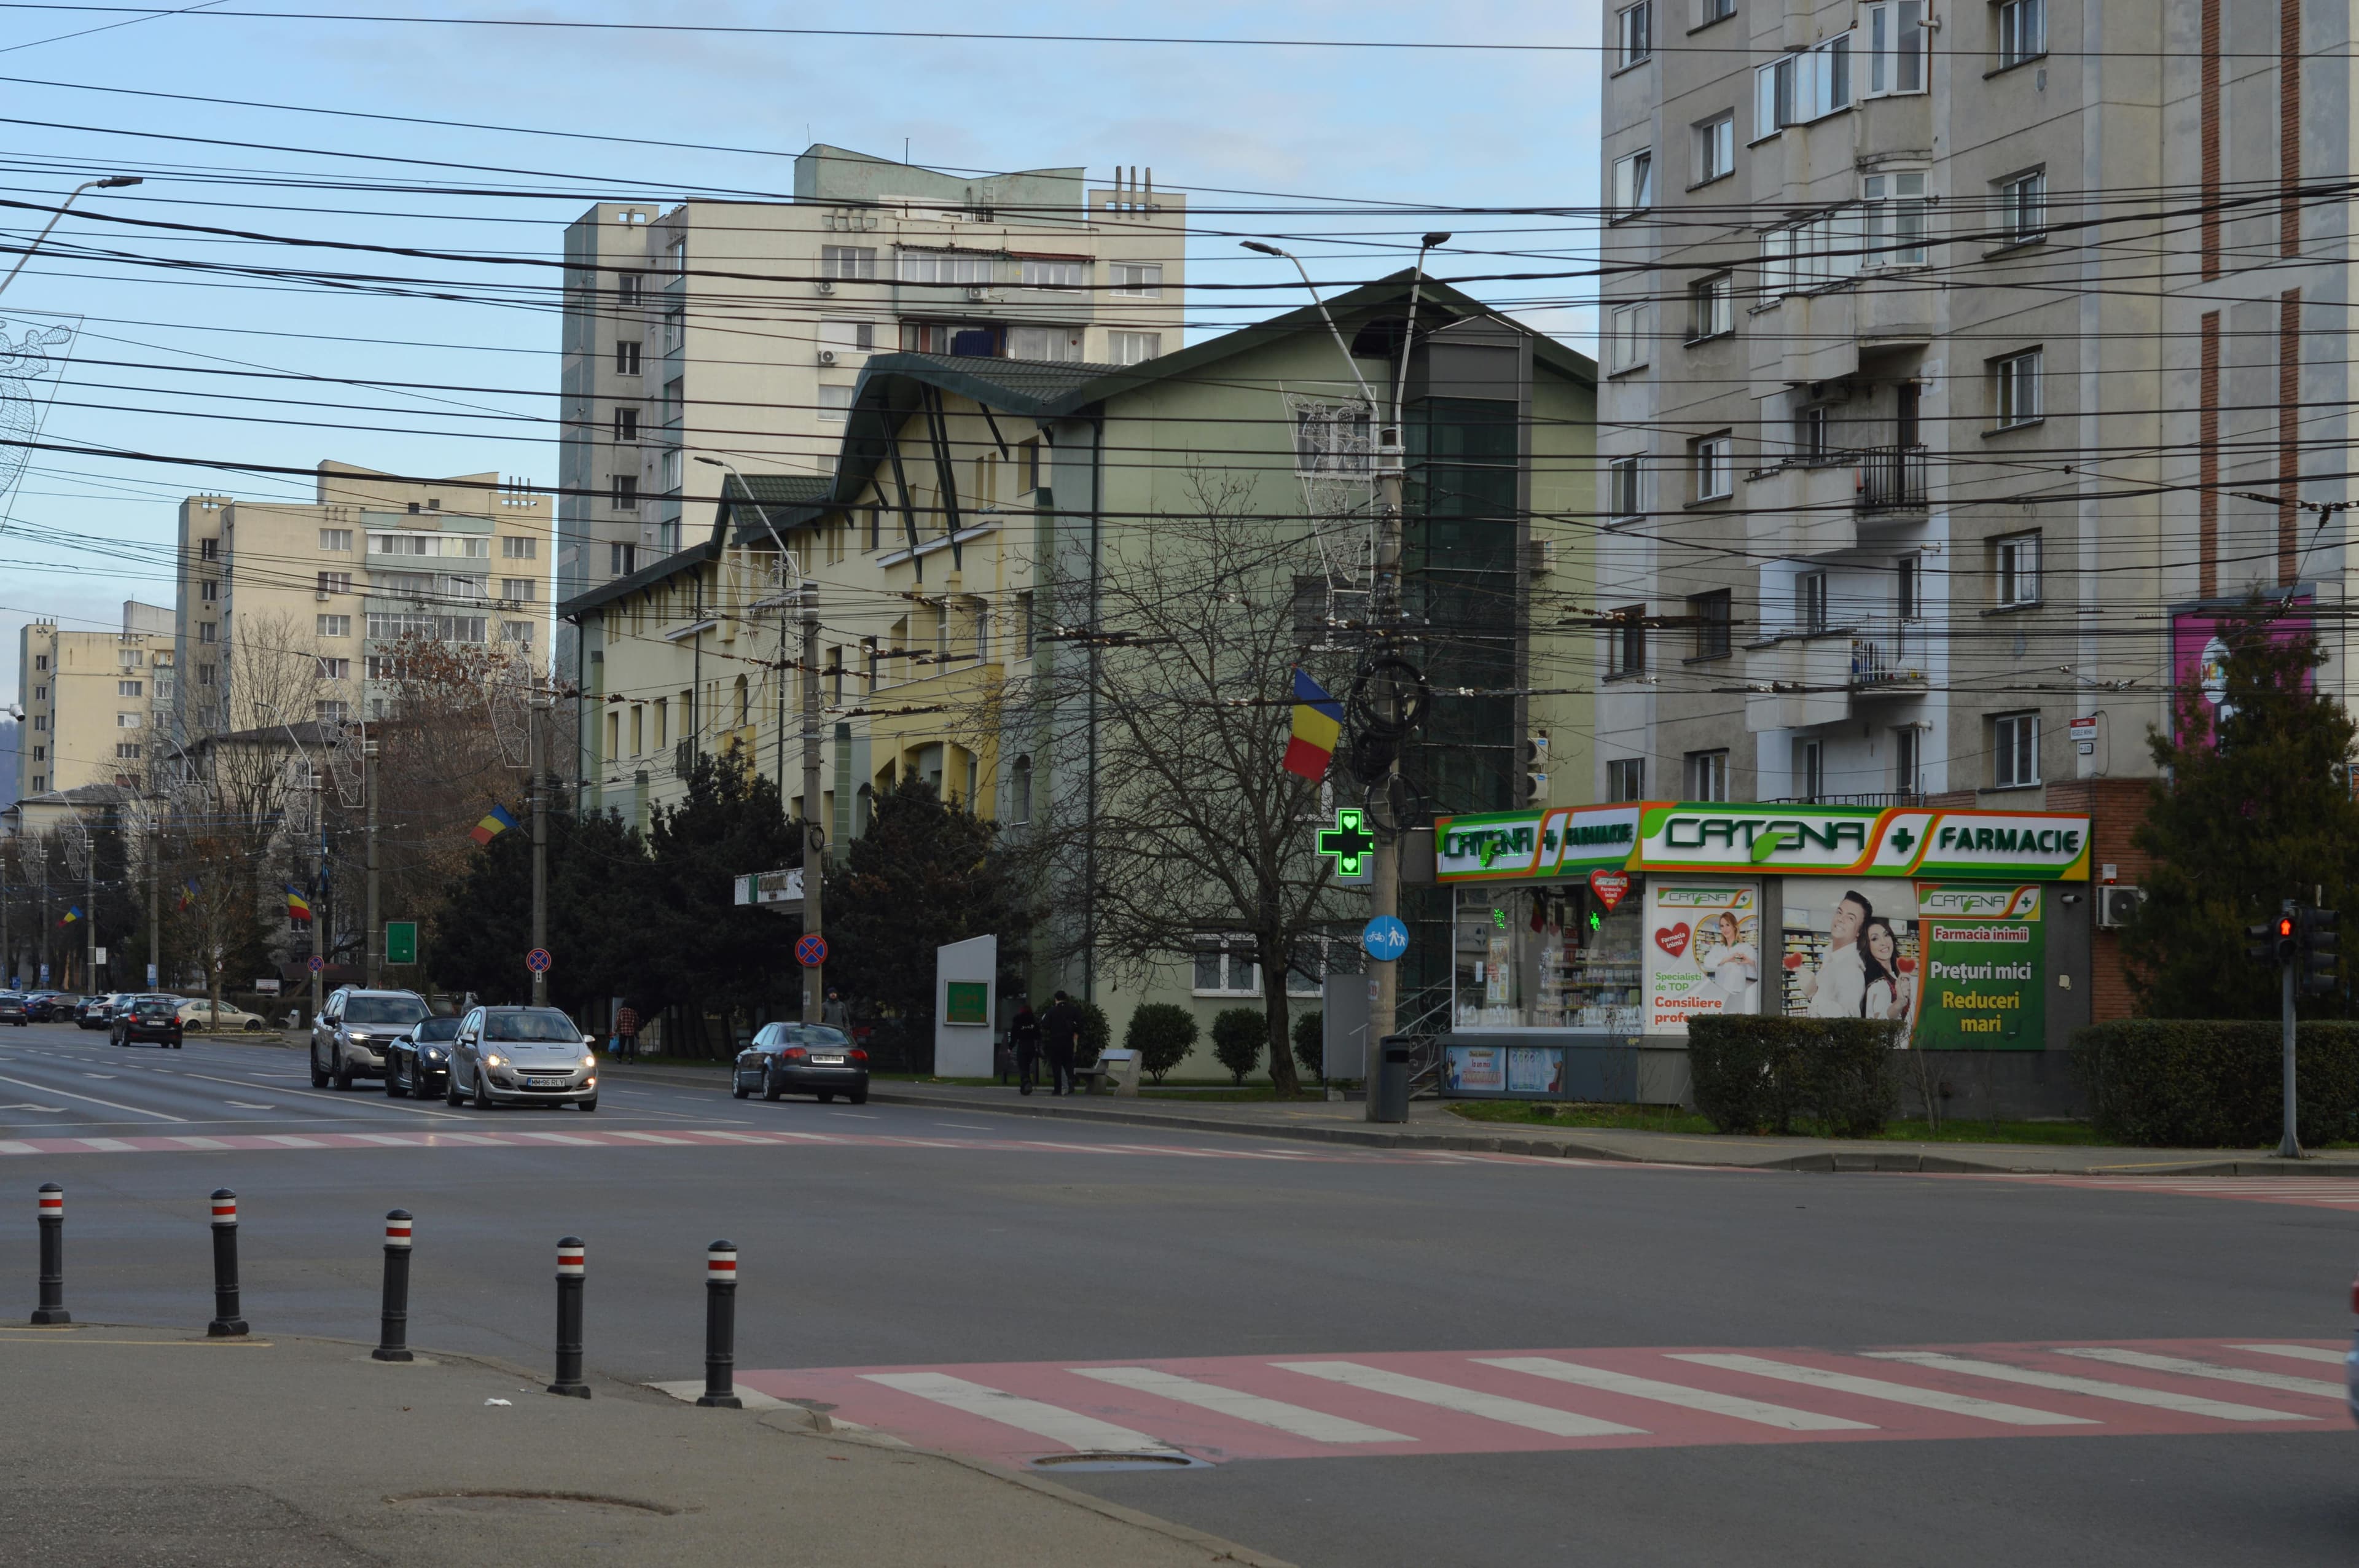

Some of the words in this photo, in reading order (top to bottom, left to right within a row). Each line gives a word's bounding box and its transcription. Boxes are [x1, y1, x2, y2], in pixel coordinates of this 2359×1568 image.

[1444, 827, 1534, 865] CATENA
[1566, 824, 1633, 846] FARMACIE
[1666, 818, 1865, 860] CATENA
[1939, 827, 2078, 852] FARMACIE
[1669, 892, 1727, 903] CATENA
[1931, 895, 2005, 910] CATENA
[1661, 932, 1686, 943] Farmacia
[1935, 928, 1990, 940] Farmacia
[1993, 928, 2028, 941] inimii
[1665, 940, 1684, 950] inimii
[1930, 961, 1992, 985] Prețuri
[1995, 961, 2032, 980] mici
[1655, 983, 1667, 991] de
[1669, 983, 1689, 991] TOP
[1654, 996, 1723, 1008] Consiliere
[1942, 989, 2020, 1009] Reduceri
[1960, 1013, 2002, 1032] mari
